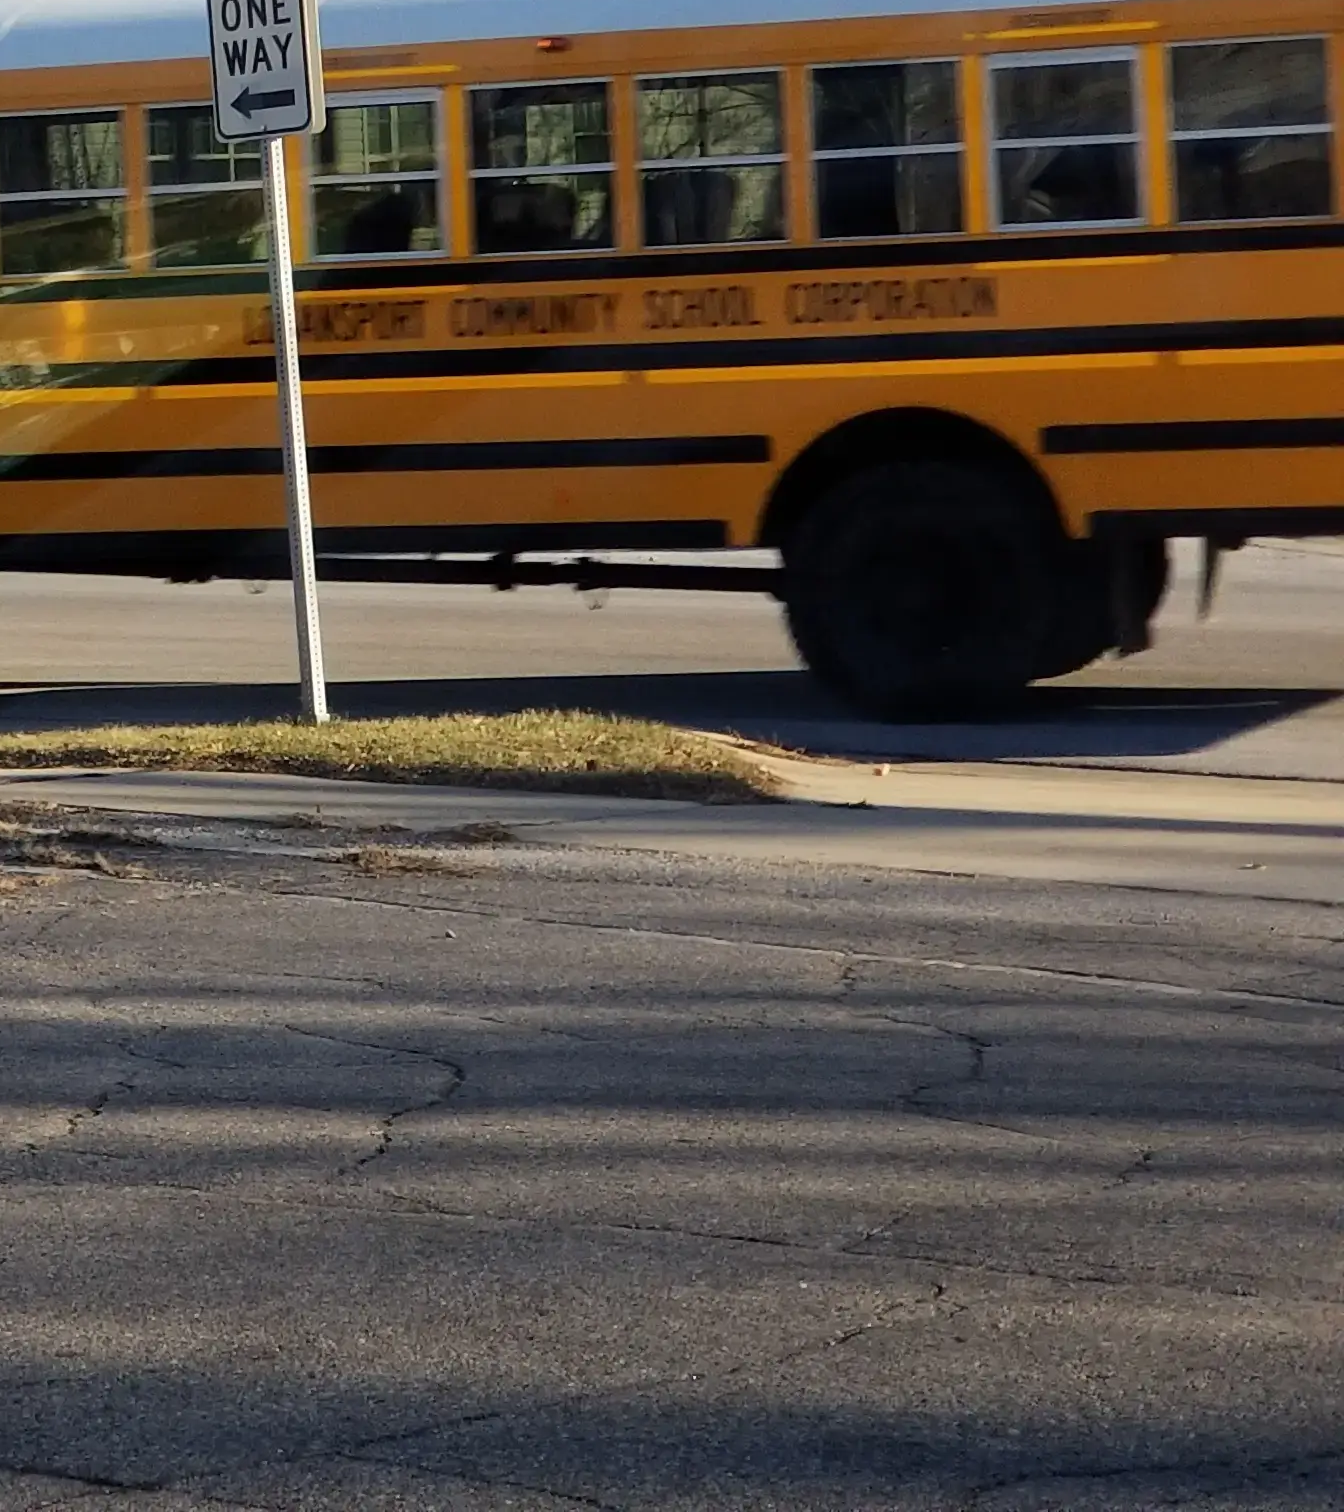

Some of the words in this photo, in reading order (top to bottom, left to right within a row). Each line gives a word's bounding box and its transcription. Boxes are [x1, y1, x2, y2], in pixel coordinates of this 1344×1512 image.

[223, 33, 293, 76] WAY
[451, 293, 622, 338] COMMUNITY
[643, 285, 766, 330] SCHOOL
[786, 276, 998, 325] CORPORATION
